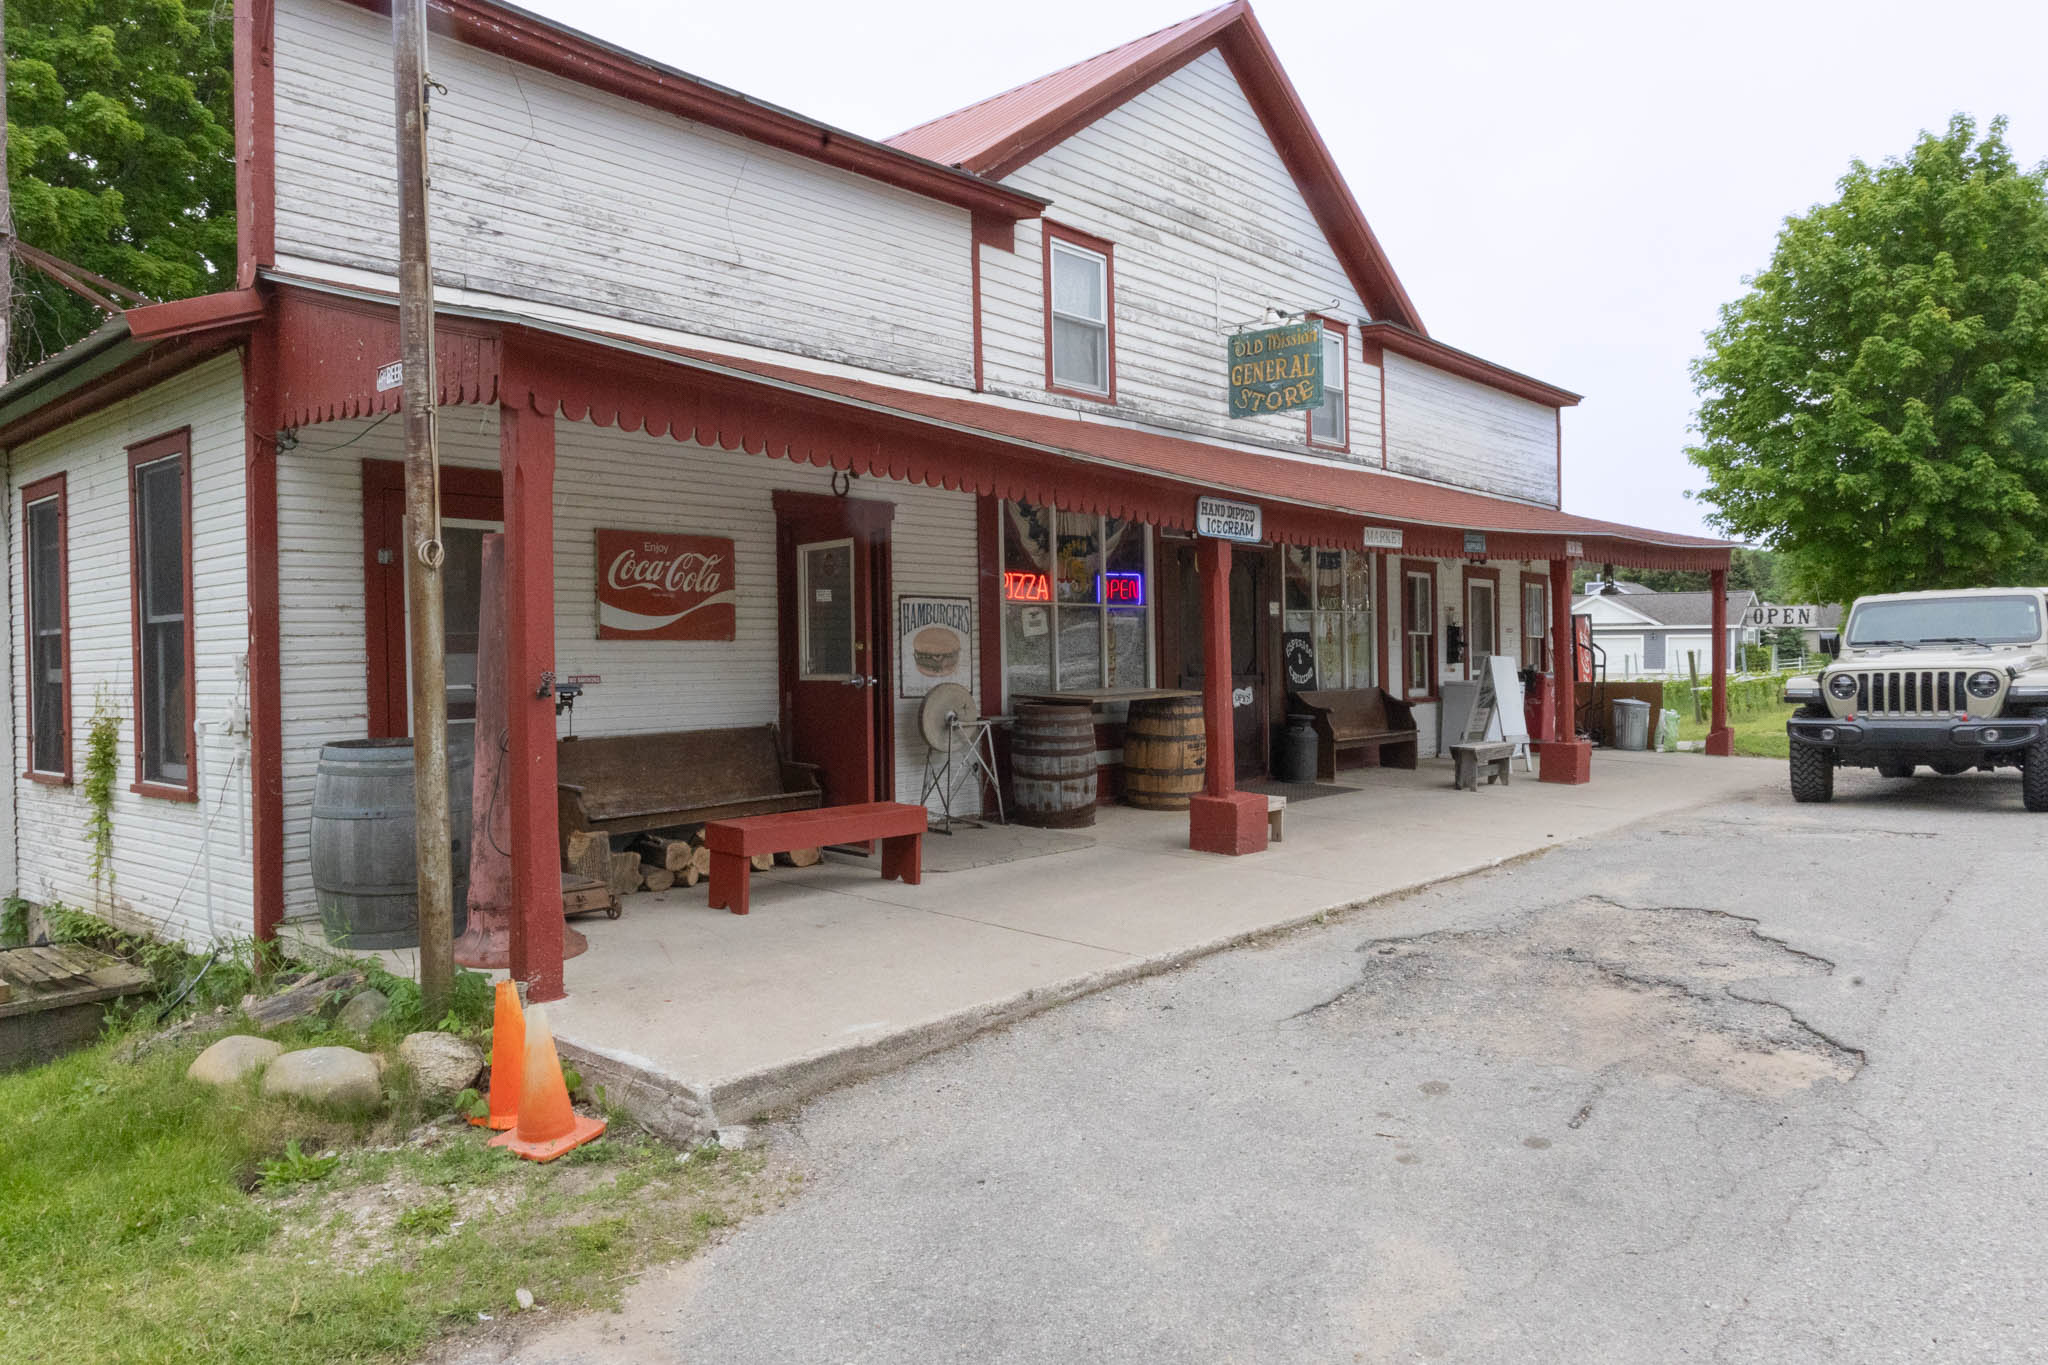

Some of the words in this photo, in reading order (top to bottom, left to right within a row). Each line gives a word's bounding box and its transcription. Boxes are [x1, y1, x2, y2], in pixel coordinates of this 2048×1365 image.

[1234, 338, 1264, 357] OLD
[1266, 327, 1319, 351] Mission
[1231, 353, 1316, 387] GENERAL
[1234, 379, 1315, 412] STORE
[1201, 501, 1226, 517] HAND
[1227, 505, 1256, 523] DIPPED
[1207, 517, 1222, 533] ICE
[1222, 520, 1255, 537] CREAM
[643, 541, 669, 553] Enjoy
[607, 549, 726, 593] Coca-Cola
[902, 602, 970, 636] HAMBURGERS
[1752, 607, 1811, 625] OPEN
